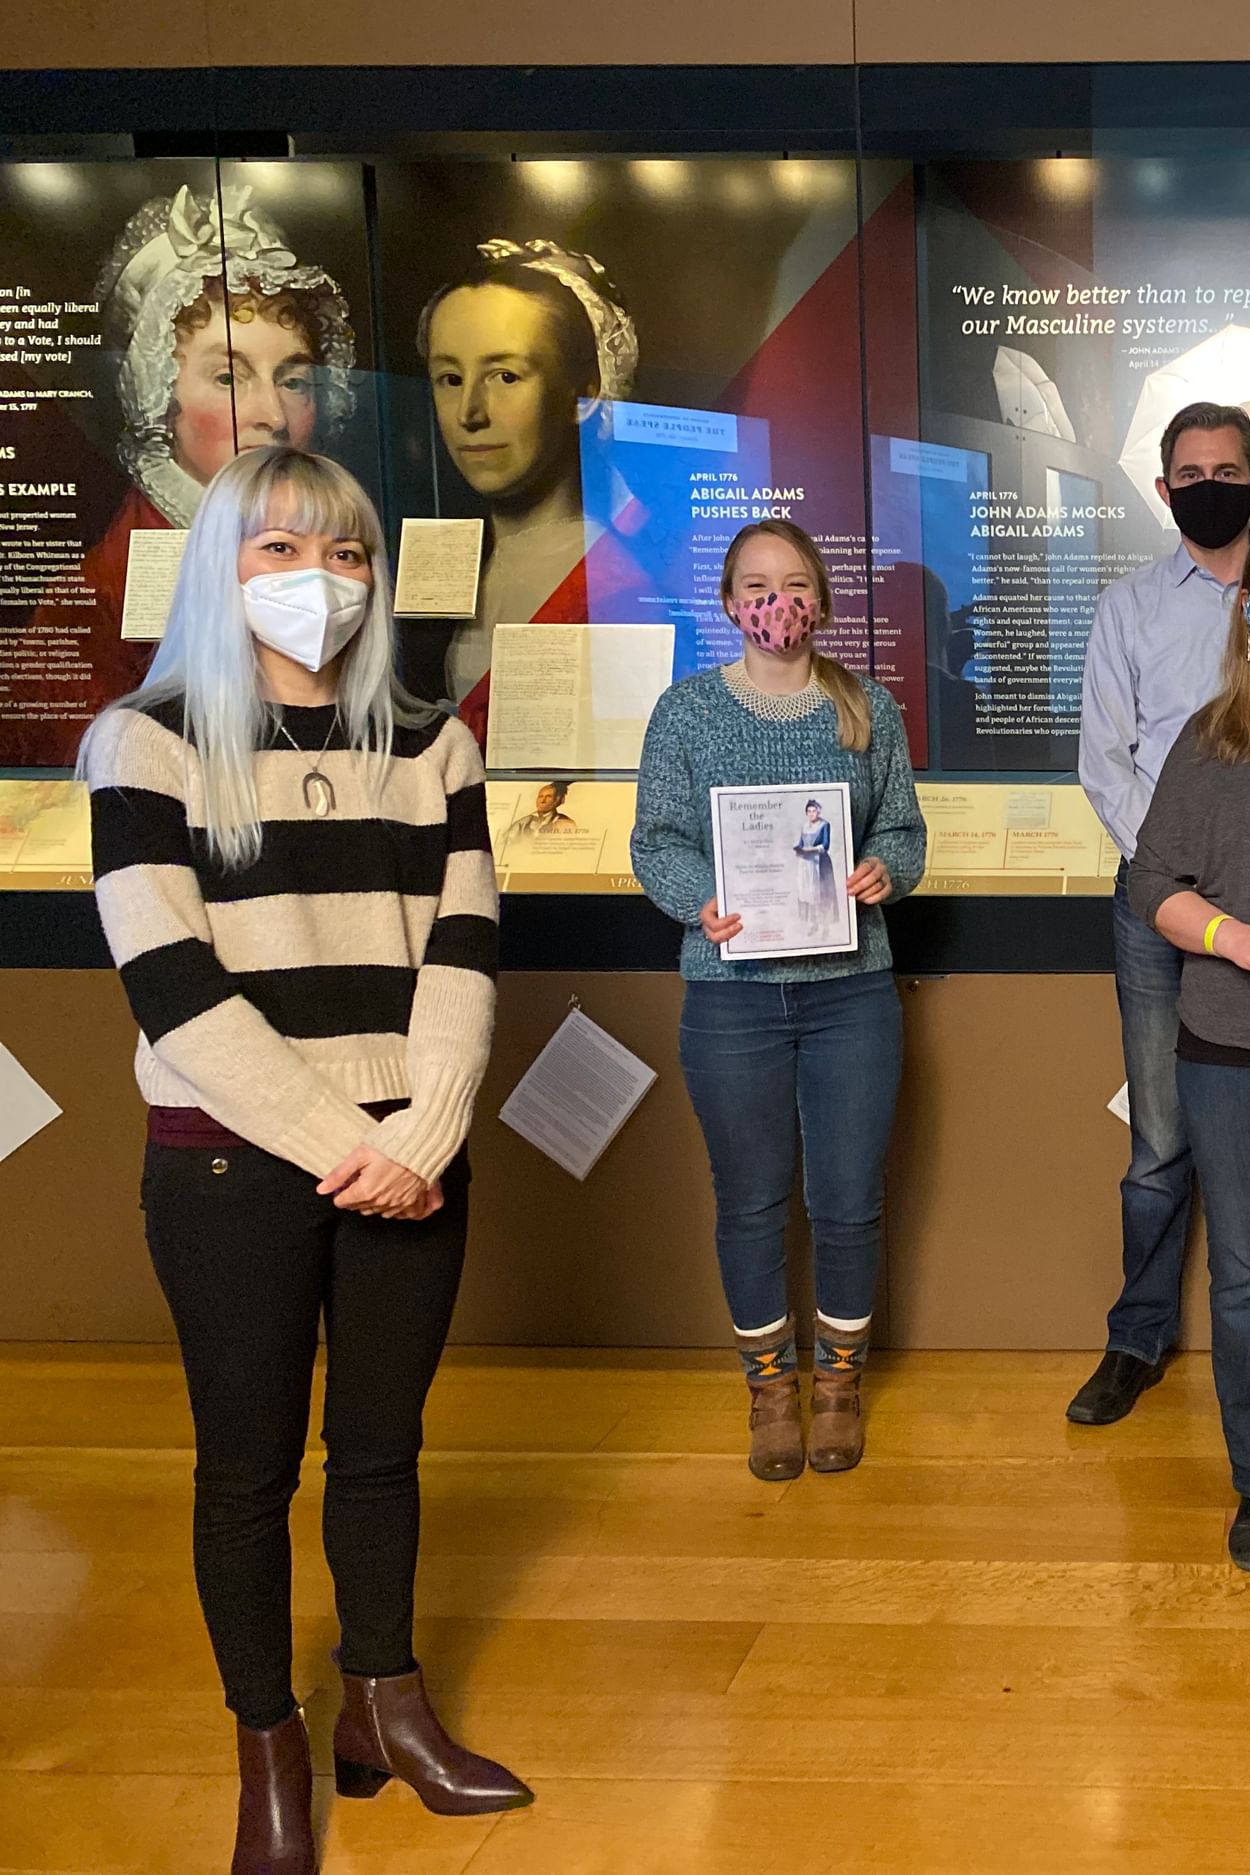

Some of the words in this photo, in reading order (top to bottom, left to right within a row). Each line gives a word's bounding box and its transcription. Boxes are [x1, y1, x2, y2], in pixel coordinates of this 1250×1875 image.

[15, 286, 31, 300] [in
[952, 286, 995, 305] "We
[1002, 285, 1061, 305] know
[1066, 285, 1130, 305] better
[1136, 285, 1187, 304] than
[1195, 288, 1215, 304] to
[21, 302, 61, 315] equally
[64, 302, 99, 313] liberal
[14, 318, 35, 329] and
[38, 318, 59, 329] had
[961, 319, 1000, 335] our
[1005, 314, 1115, 335] Masculine
[4, 336, 15, 346] to
[17, 337, 25, 345] a
[27, 335, 55, 347] Vote,
[57, 335, 62, 345] I
[64, 334, 101, 345] should
[1128, 347, 1151, 355] JOHN
[20, 351, 42, 364] [my
[45, 351, 72, 364] vote]
[1129, 360, 1149, 369] April
[35, 390, 57, 398] MARY
[58, 390, 94, 399] CRANCH,
[689, 473, 718, 482] APRIL
[719, 473, 738, 482] 1776
[8, 483, 77, 496] EXAMPLE
[690, 487, 749, 501] ABIGAIL
[751, 487, 805, 501] ADAMS
[969, 491, 997, 501] APRIL
[998, 490, 1018, 500] 1776
[11, 511, 49, 521] propertied
[691, 506, 749, 519] PUSHES
[752, 506, 792, 519] BACK
[969, 506, 1012, 520] JOHN
[1015, 506, 1068, 519] ADAMS
[1071, 506, 1126, 519] MOCKS
[970, 525, 1029, 538] ABIGAIL
[1031, 525, 1085, 537] ADAMS
[692, 534, 714, 542] After
[715, 534, 731, 543] John
[825, 534, 856, 542] Adams's
[1002, 553, 1016, 561] but
[1044, 553, 1063, 562] John
[1064, 553, 1089, 561] Adams
[1090, 553, 1116, 562] replied
[1126, 553, 1153, 562] Abigail
[971, 565, 1003, 573] Adams's
[1061, 577, 1085, 586] repeal
[999, 594, 1029, 603] equated
[975, 693, 992, 701] John
[729, 800, 783, 812] Remember
[749, 812, 765, 821] the
[742, 821, 774, 832] Ladies
